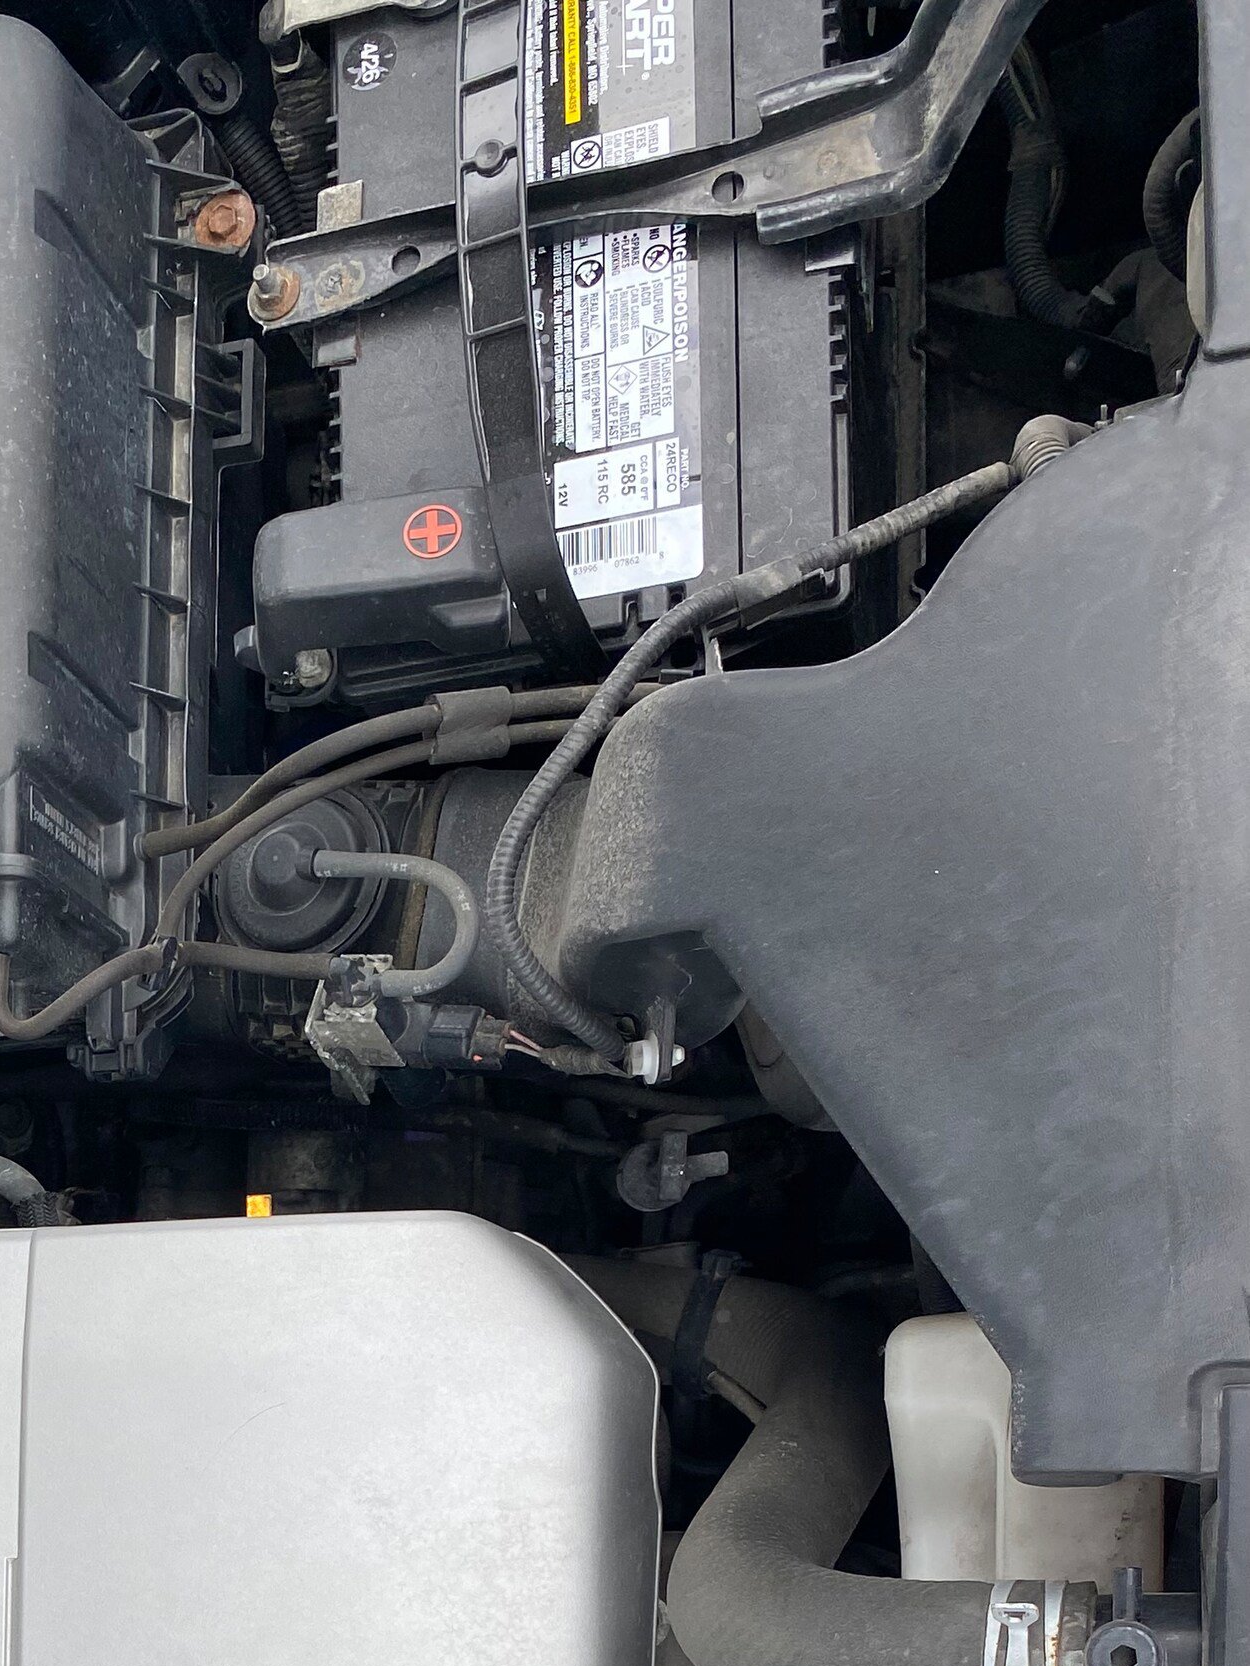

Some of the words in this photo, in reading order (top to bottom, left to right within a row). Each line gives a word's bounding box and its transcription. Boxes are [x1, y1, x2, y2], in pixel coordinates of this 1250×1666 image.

[567, 31, 577, 54] CALL
[360, 43, 381, 84] 4/26
[613, 132, 623, 148] CAN
[636, 127, 647, 152] EYES.
[648, 123, 659, 154] SHIELD
[648, 227, 660, 241] NO
[589, 292, 599, 313] READ
[608, 293, 619, 322] SEVERE
[630, 288, 640, 304] CAN
[640, 285, 651, 307] ACID
[652, 281, 664, 325] SULFURIC
[579, 294, 590, 352] INSTRUCTIONS.
[630, 305, 640, 330] CAUSE
[554, 325, 565, 355] PROPER
[609, 322, 619, 353] BURNS.
[620, 333, 630, 346] OR
[581, 360, 590, 371] DO
[590, 357, 599, 369] DO
[639, 361, 650, 385] WITH
[661, 356, 672, 384] FLUSH
[581, 372, 591, 388] NOT
[591, 370, 600, 386] NOT
[650, 358, 662, 417] IMMEDIATELY
[591, 387, 601, 407] OPEN
[608, 395, 619, 417] HELP
[639, 385, 651, 420] WATER.
[661, 385, 673, 408] EYES
[591, 408, 602, 443] BATTERY.
[608, 419, 619, 444] FAST.
[619, 402, 630, 442] MEDICAL
[630, 421, 641, 438] GET
[597, 458, 609, 482] 115
[639, 454, 649, 474] CCA
[665, 441, 679, 494] 24RECO
[679, 447, 690, 472] PART
[620, 462, 637, 497] 585
[680, 472, 691, 491] NO.
[557, 483, 569, 508] 12V
[597, 484, 610, 505] RC
